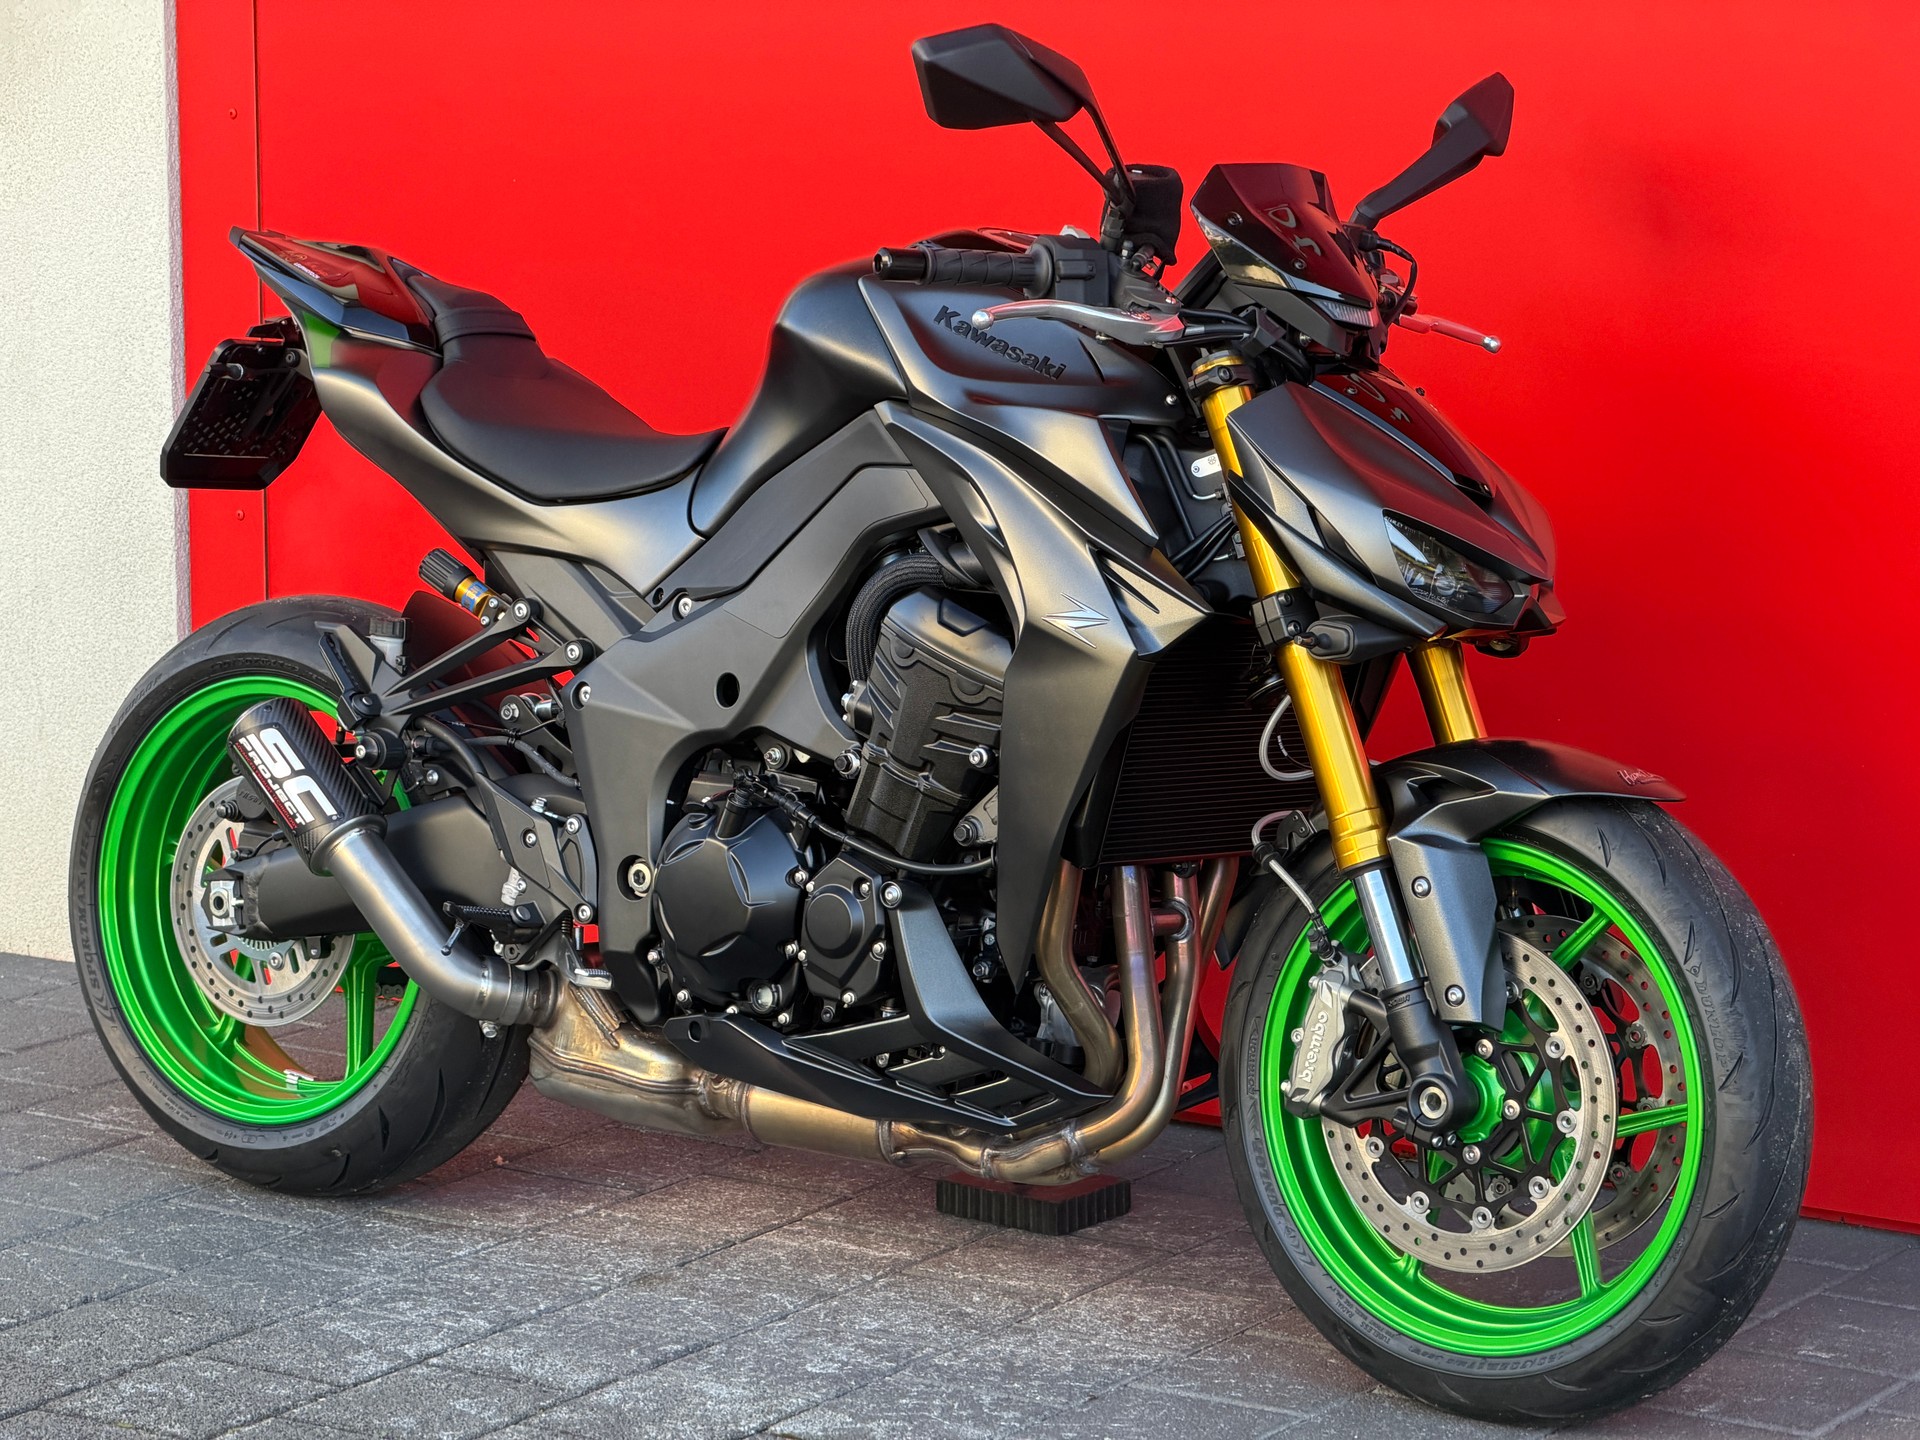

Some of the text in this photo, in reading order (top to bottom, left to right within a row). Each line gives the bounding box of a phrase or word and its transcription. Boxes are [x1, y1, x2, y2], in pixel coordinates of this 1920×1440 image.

[934, 305, 1067, 380] Kawasaki
[238, 737, 306, 826] PROJECT
[246, 727, 338, 823] SC
[77, 874, 101, 990] SPORTMAX
[1298, 1011, 1328, 1083] brembo
[1694, 981, 1728, 1068] DUNLOP
[1251, 1140, 1285, 1219] DUNLOP
[1336, 1298, 1391, 1344] TUBELESS RADIAL
